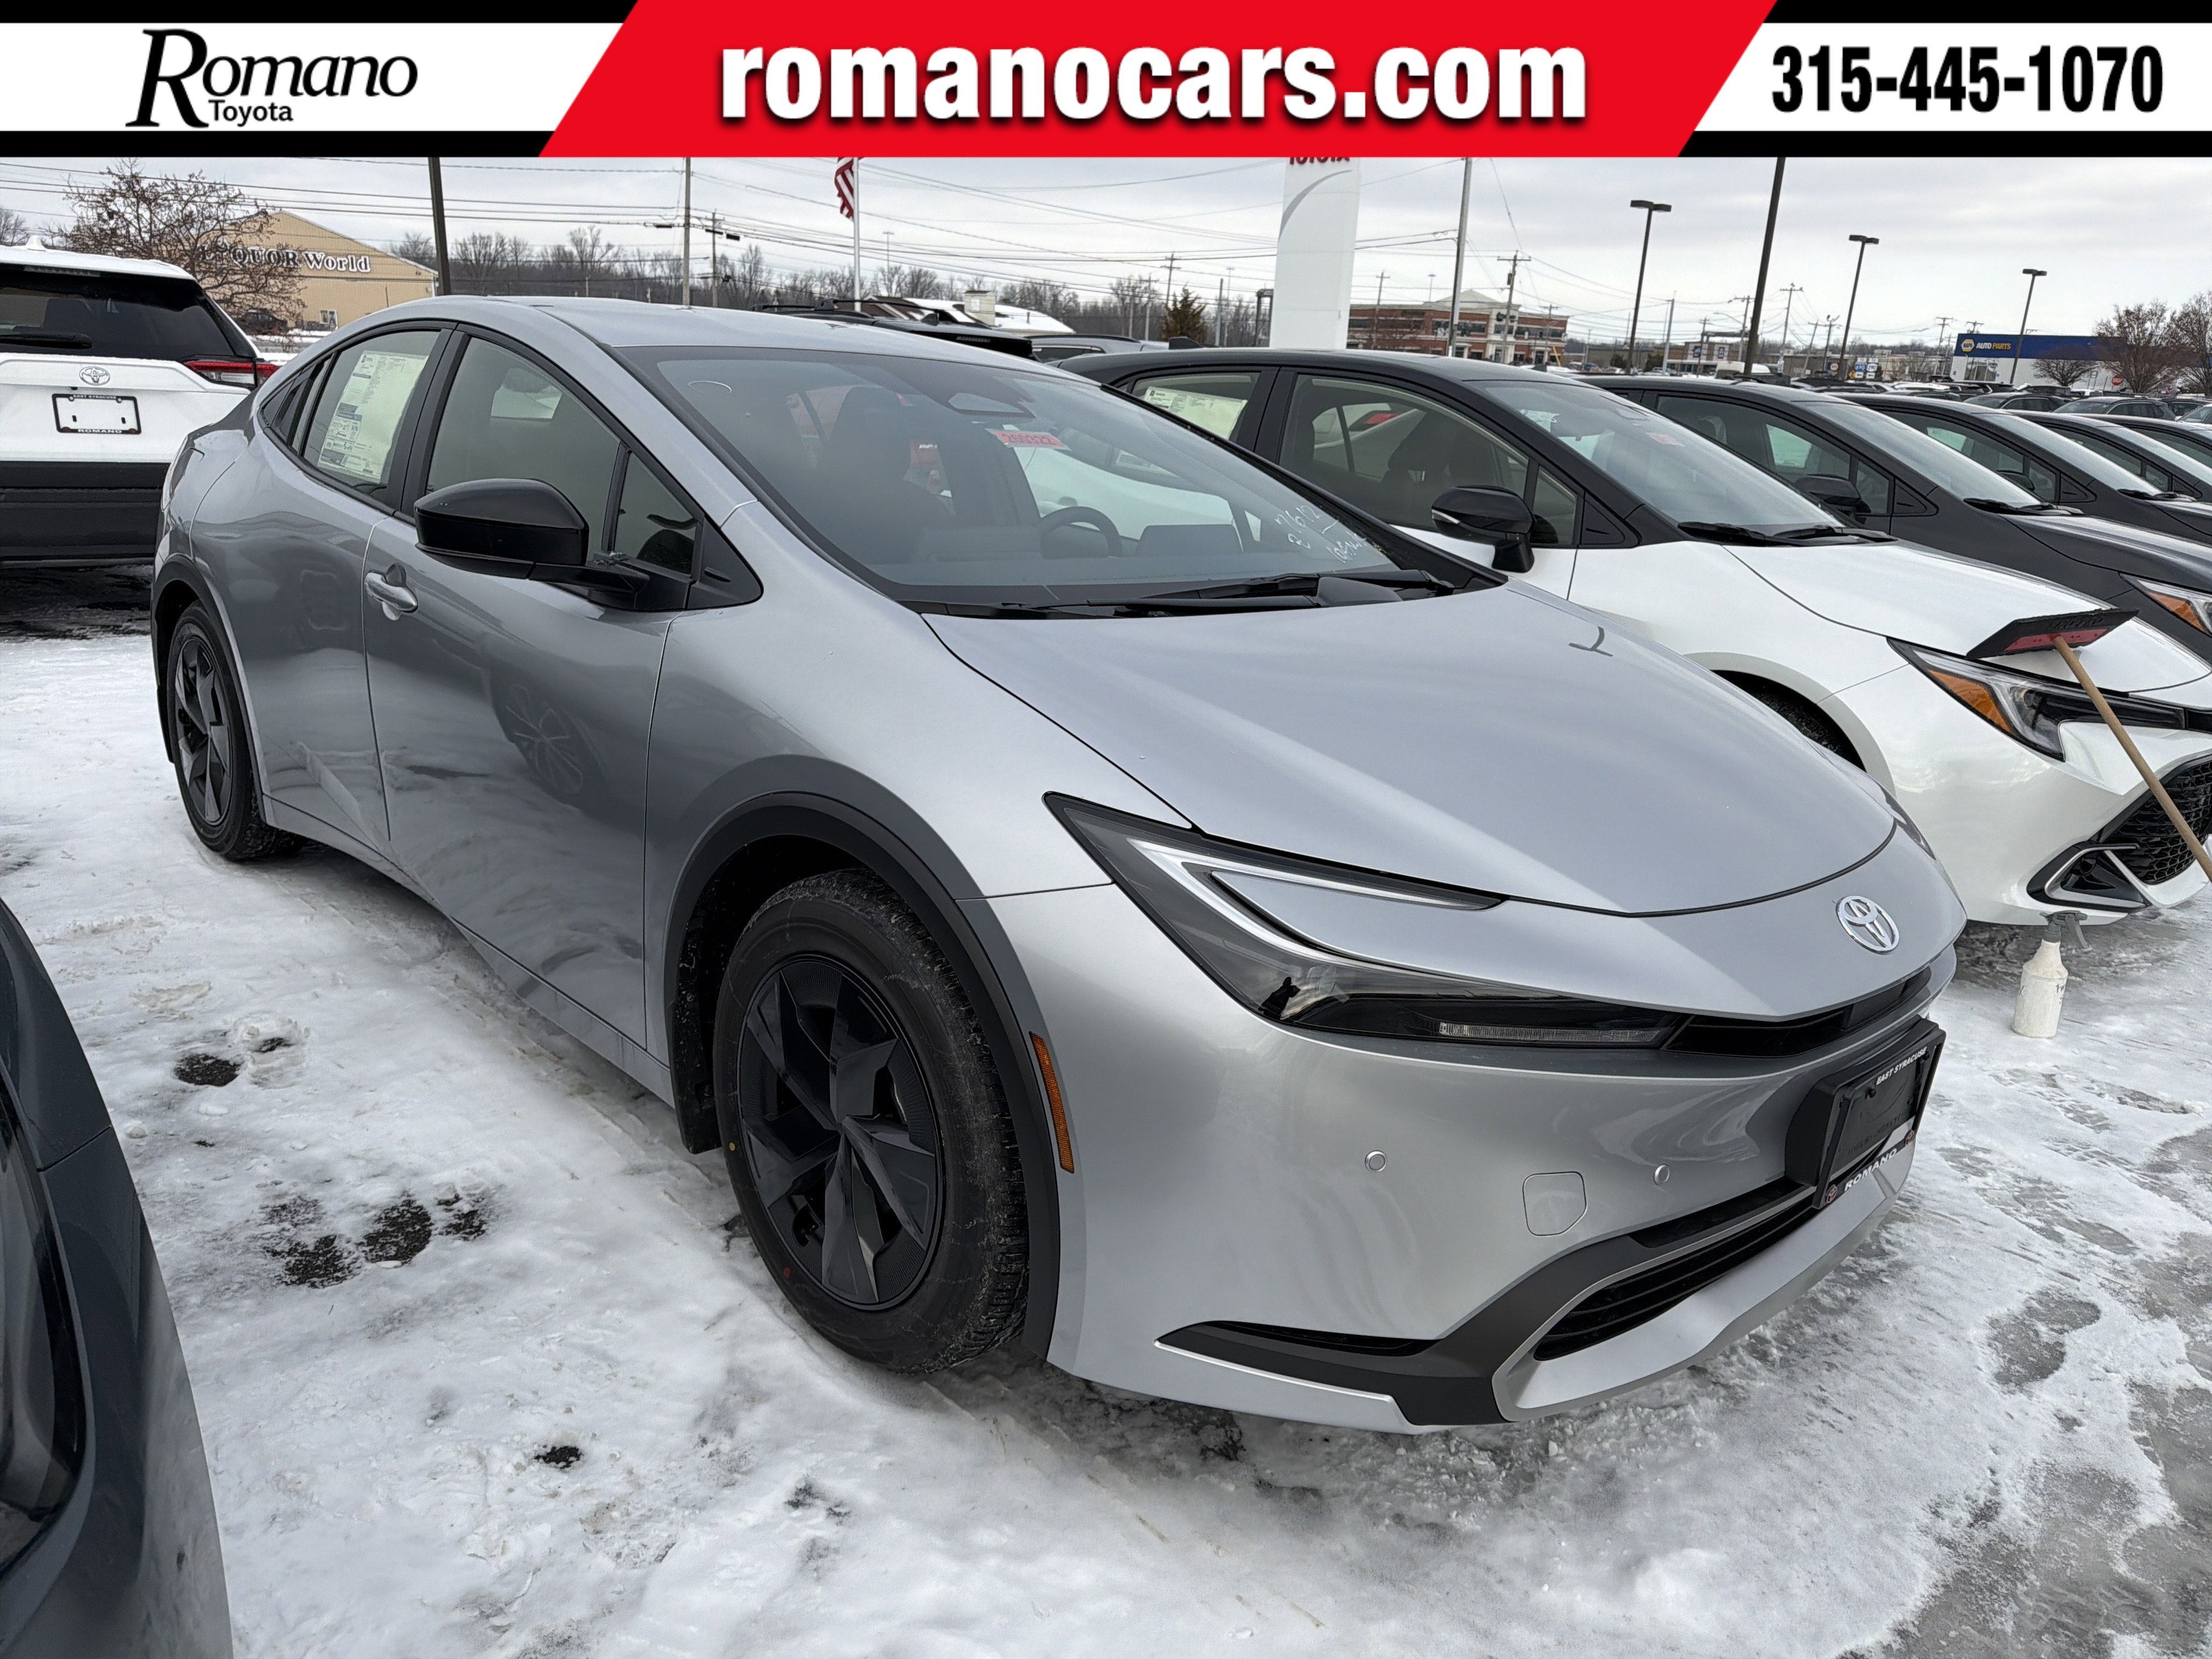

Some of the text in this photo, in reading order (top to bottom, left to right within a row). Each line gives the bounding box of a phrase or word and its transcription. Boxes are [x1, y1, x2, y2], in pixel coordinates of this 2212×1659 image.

[198, 239, 371, 272] LQUOR World
[1876, 1046, 1927, 1086] EAST SYRACUSE
[1844, 1148, 1897, 1192] ROMANO
